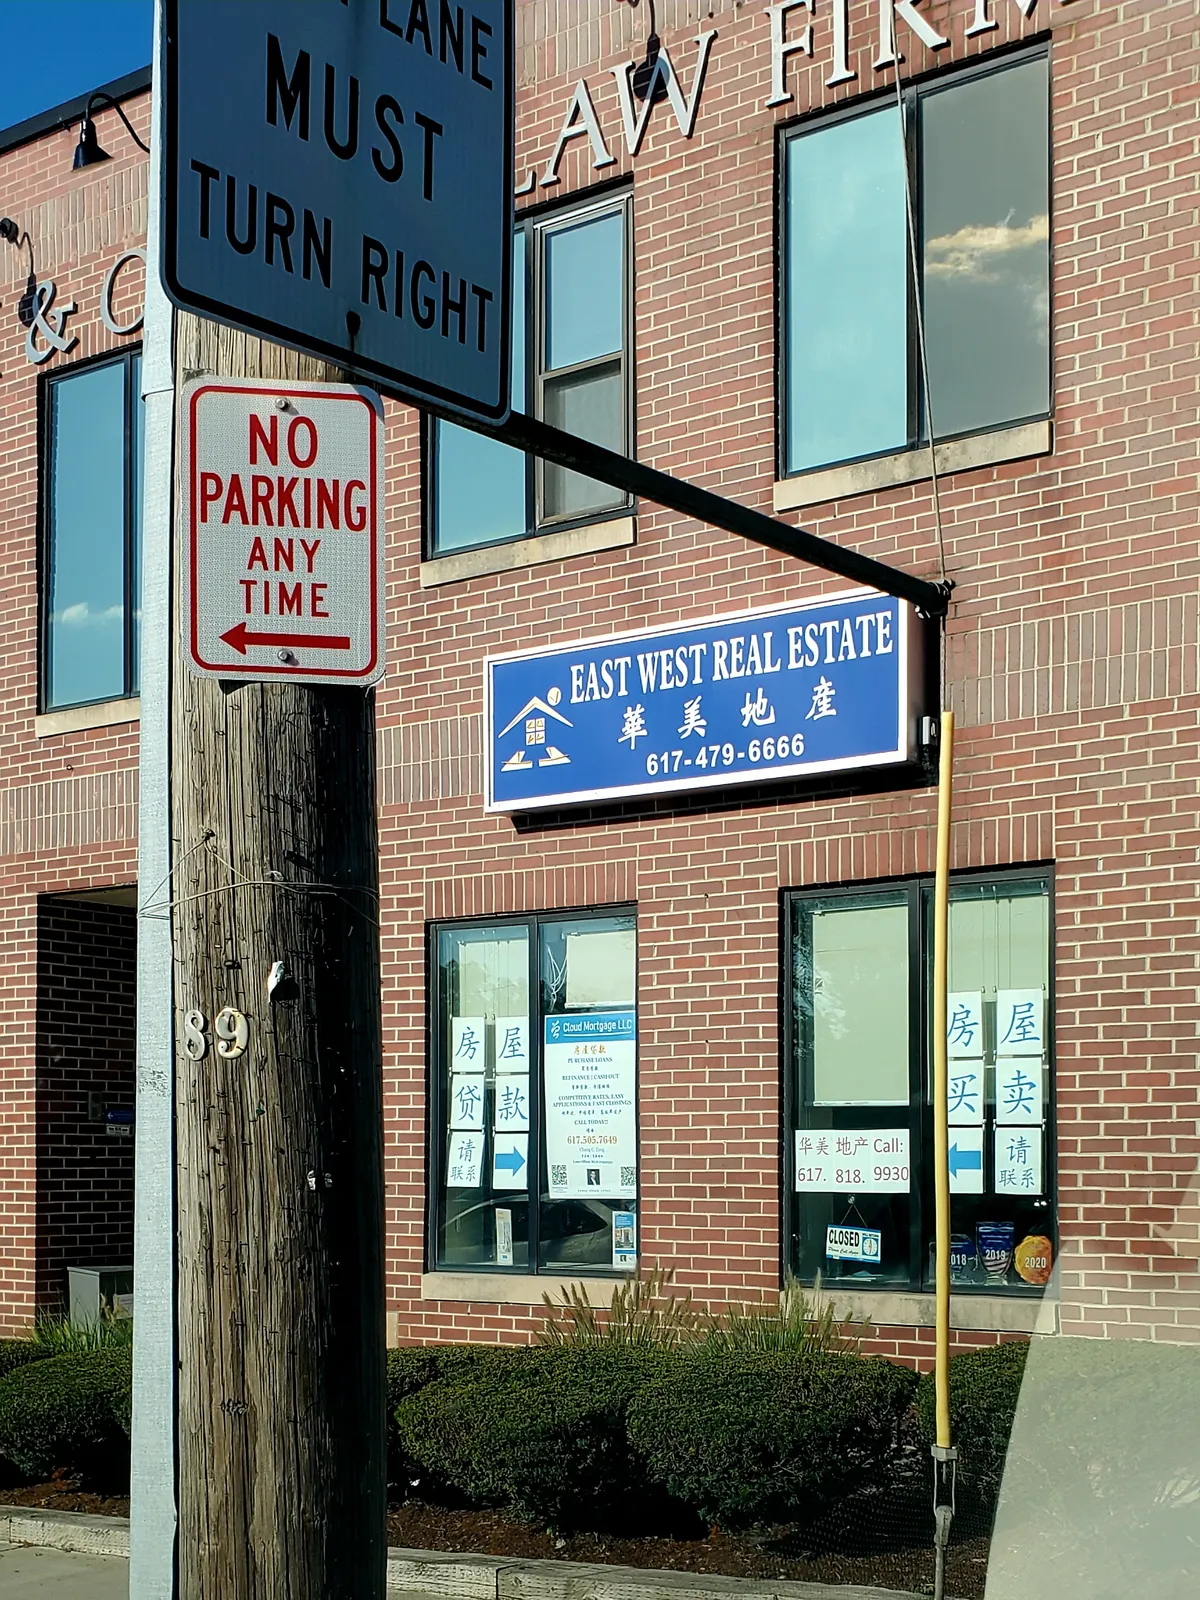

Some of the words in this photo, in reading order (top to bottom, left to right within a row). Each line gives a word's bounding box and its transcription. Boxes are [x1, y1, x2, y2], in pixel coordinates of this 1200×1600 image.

[379, 0, 493, 92] LANE
[265, 32, 444, 202] MUST
[514, 29, 718, 195] AW
[190, 159, 332, 289] TURN
[361, 234, 494, 353] RIGHT
[248, 413, 318, 468] NO
[200, 472, 367, 532] PARKING
[247, 538, 321, 573] ANY
[239, 579, 330, 618] TIME
[569, 655, 632, 704] EAST
[637, 643, 708, 694] WEST
[712, 631, 782, 682] REAL
[787, 610, 894, 669] ESTATE
[645, 733, 806, 776] 617-479-6666
[184, 1007, 250, 1061] 89
[455, 1026, 525, 1060] 房屋
[563, 1021, 582, 1032] Cloud
[583, 1020, 617, 1033] Mortgage
[617, 1019, 633, 1030] LLC
[454, 1085, 528, 1121] 贷款
[567, 1135, 618, 1145] 617.505.7649
[873, 1137, 904, 1153] Call:
[873, 1166, 909, 1181] 9930
[828, 1229, 860, 1247] CLOSED
[985, 1249, 1006, 1261] 2019
[949, 1253, 967, 1266] 018
[1024, 1256, 1047, 1269] 2020
